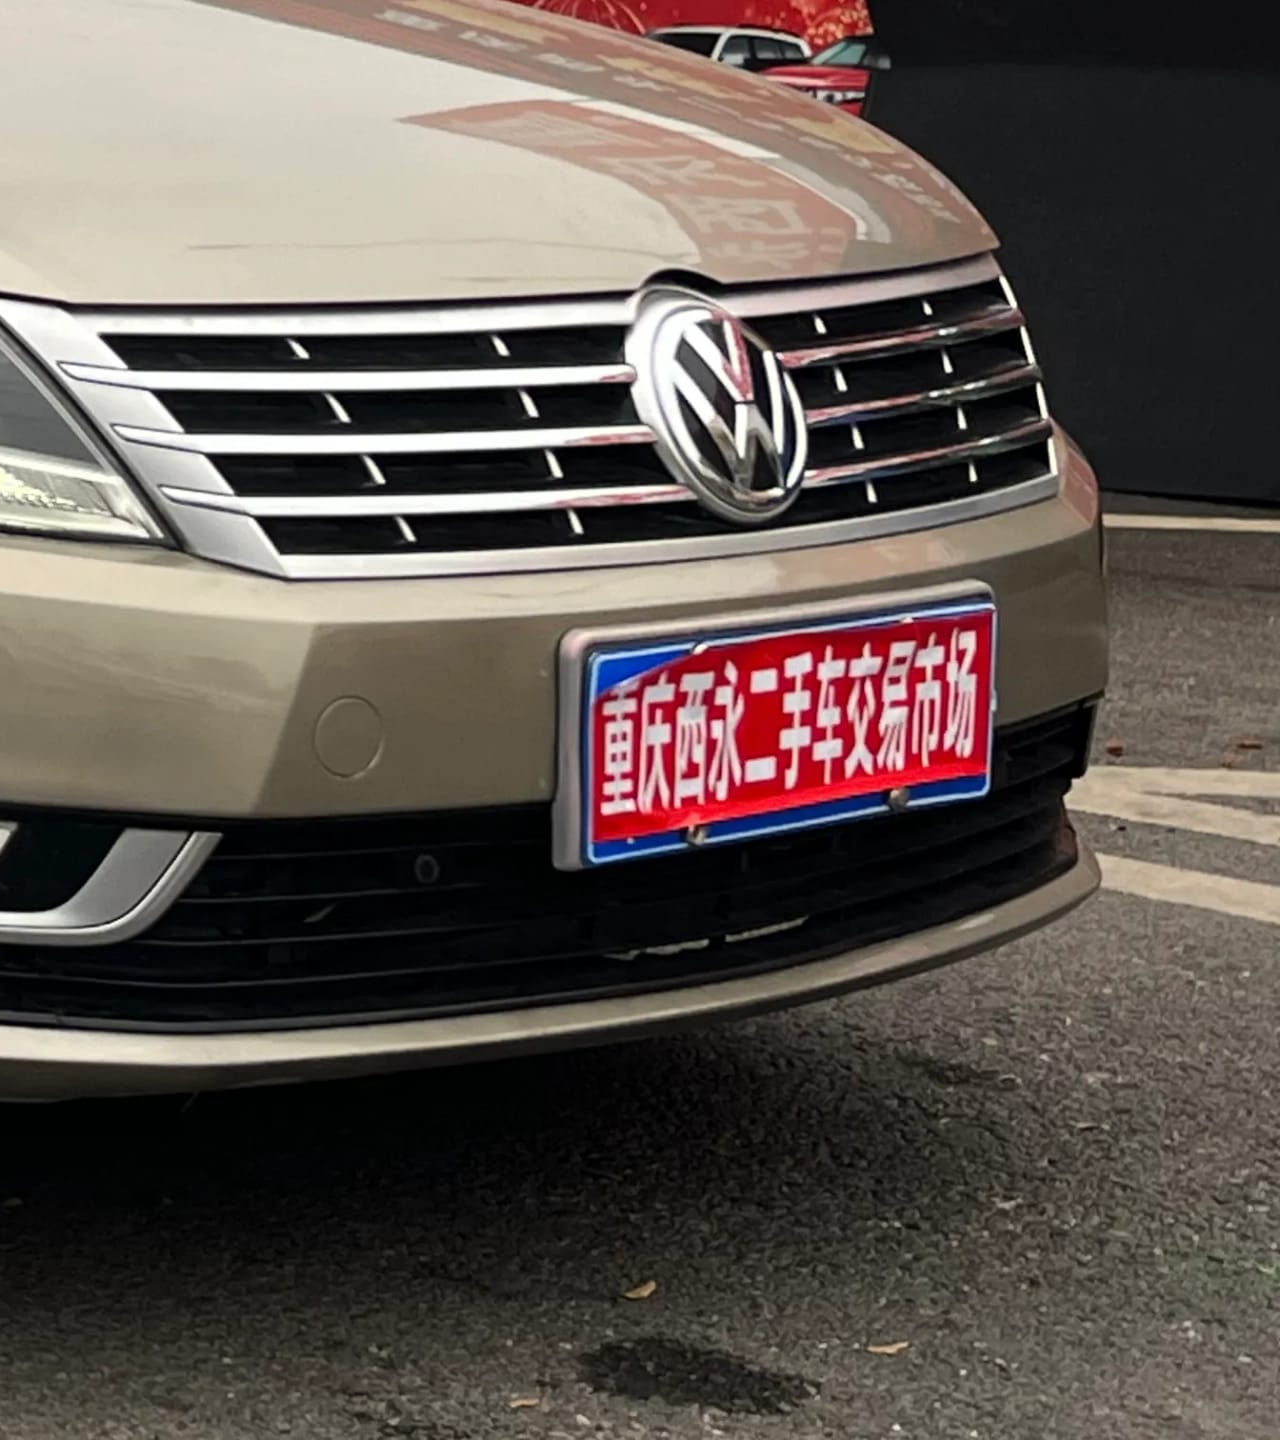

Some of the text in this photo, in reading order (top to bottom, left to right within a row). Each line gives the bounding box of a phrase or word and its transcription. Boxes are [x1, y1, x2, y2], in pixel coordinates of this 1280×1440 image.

[600, 627, 978, 816] 重庆西永二手车交易市场
